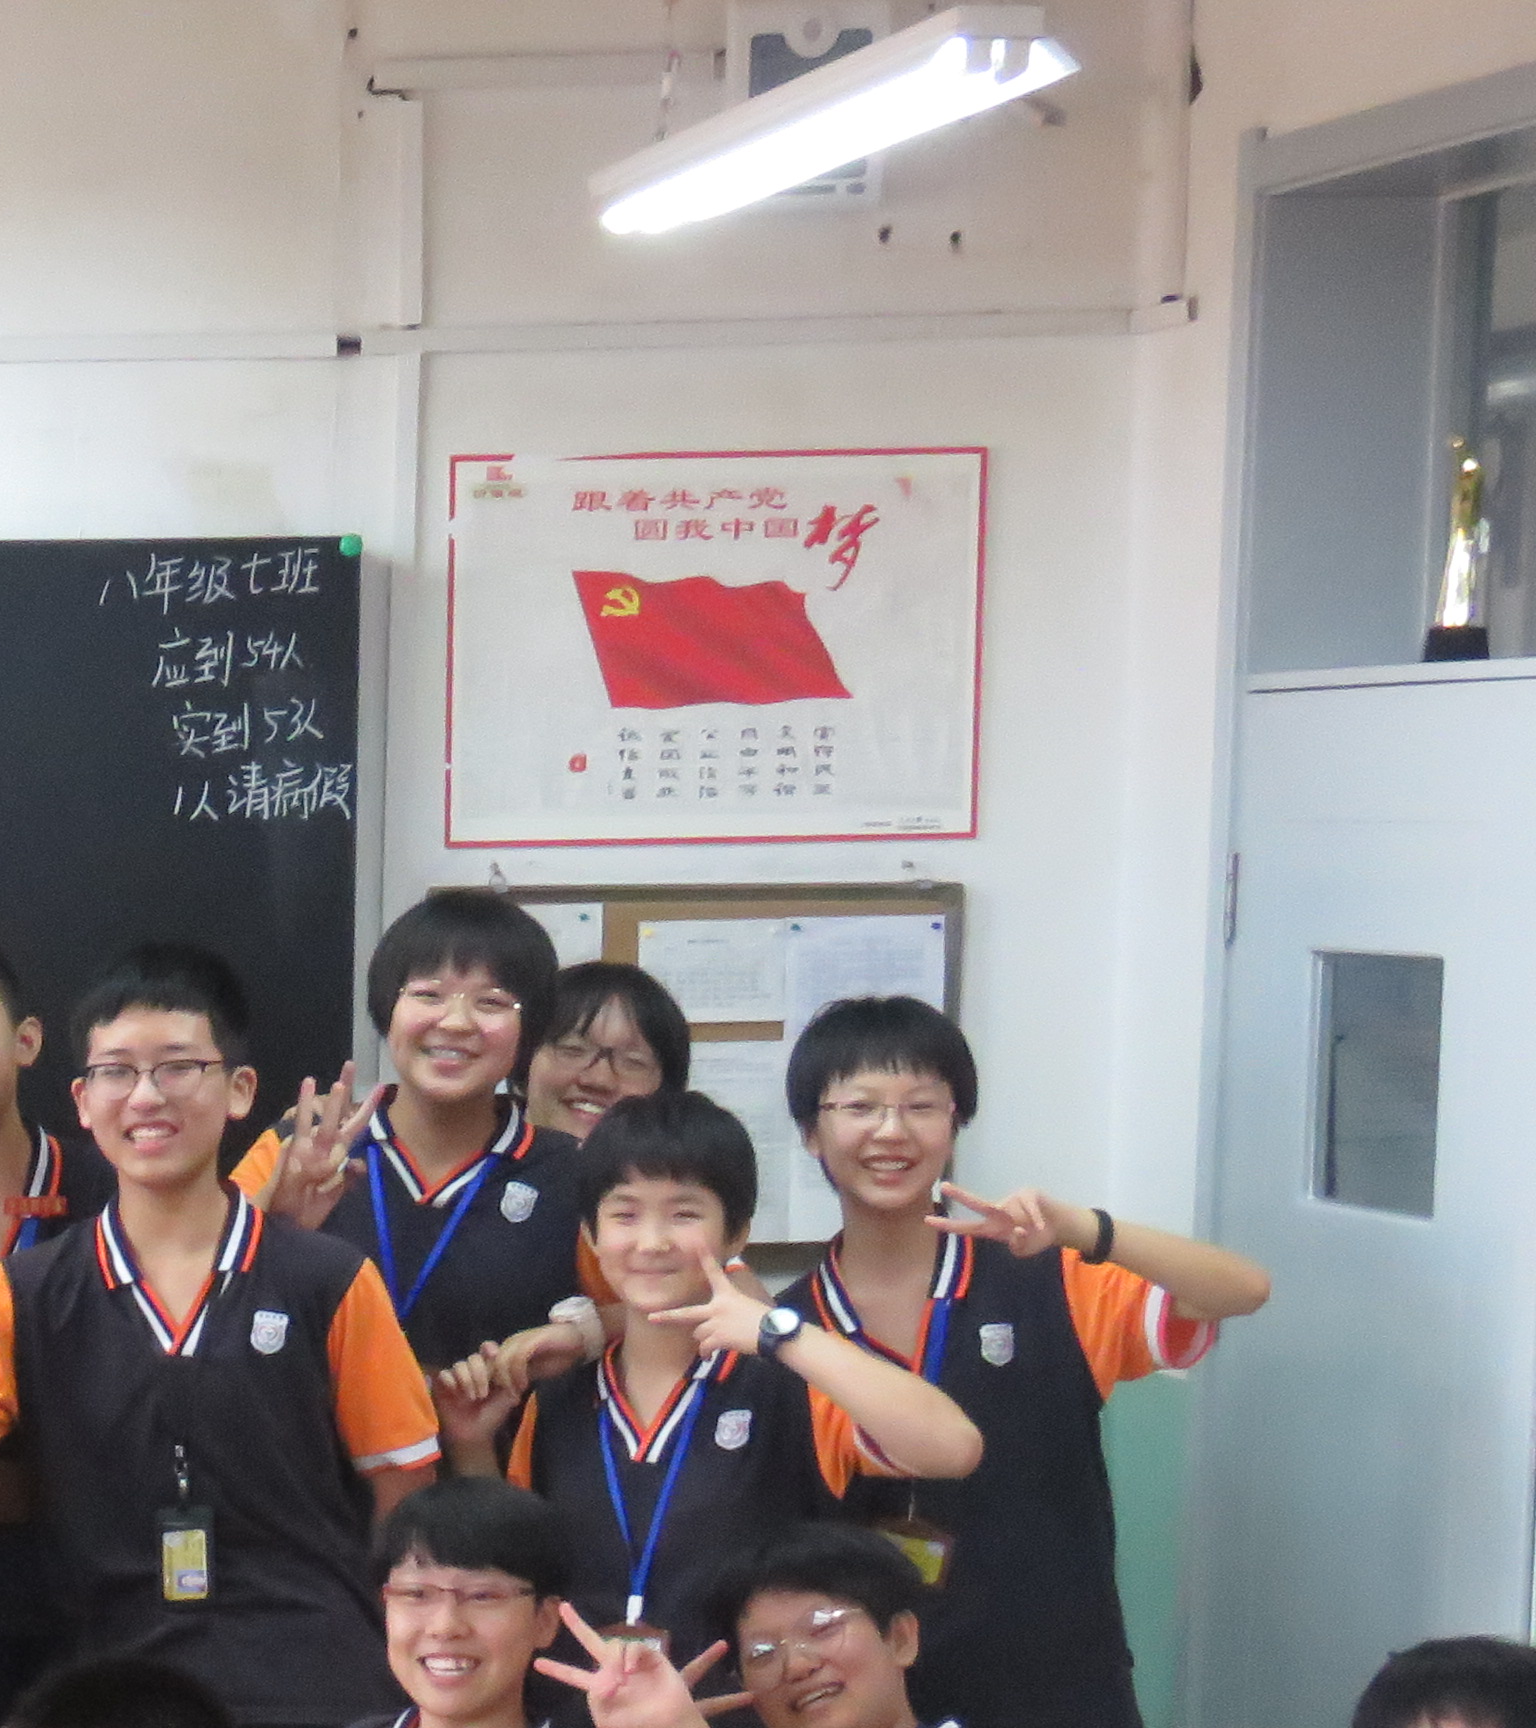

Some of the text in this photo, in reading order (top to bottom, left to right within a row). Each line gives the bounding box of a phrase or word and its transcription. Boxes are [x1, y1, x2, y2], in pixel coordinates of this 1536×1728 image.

[571, 487, 788, 512] 跟着共产党
[98, 546, 320, 616] 八年级七班
[634, 504, 880, 591] 圆我中国梦
